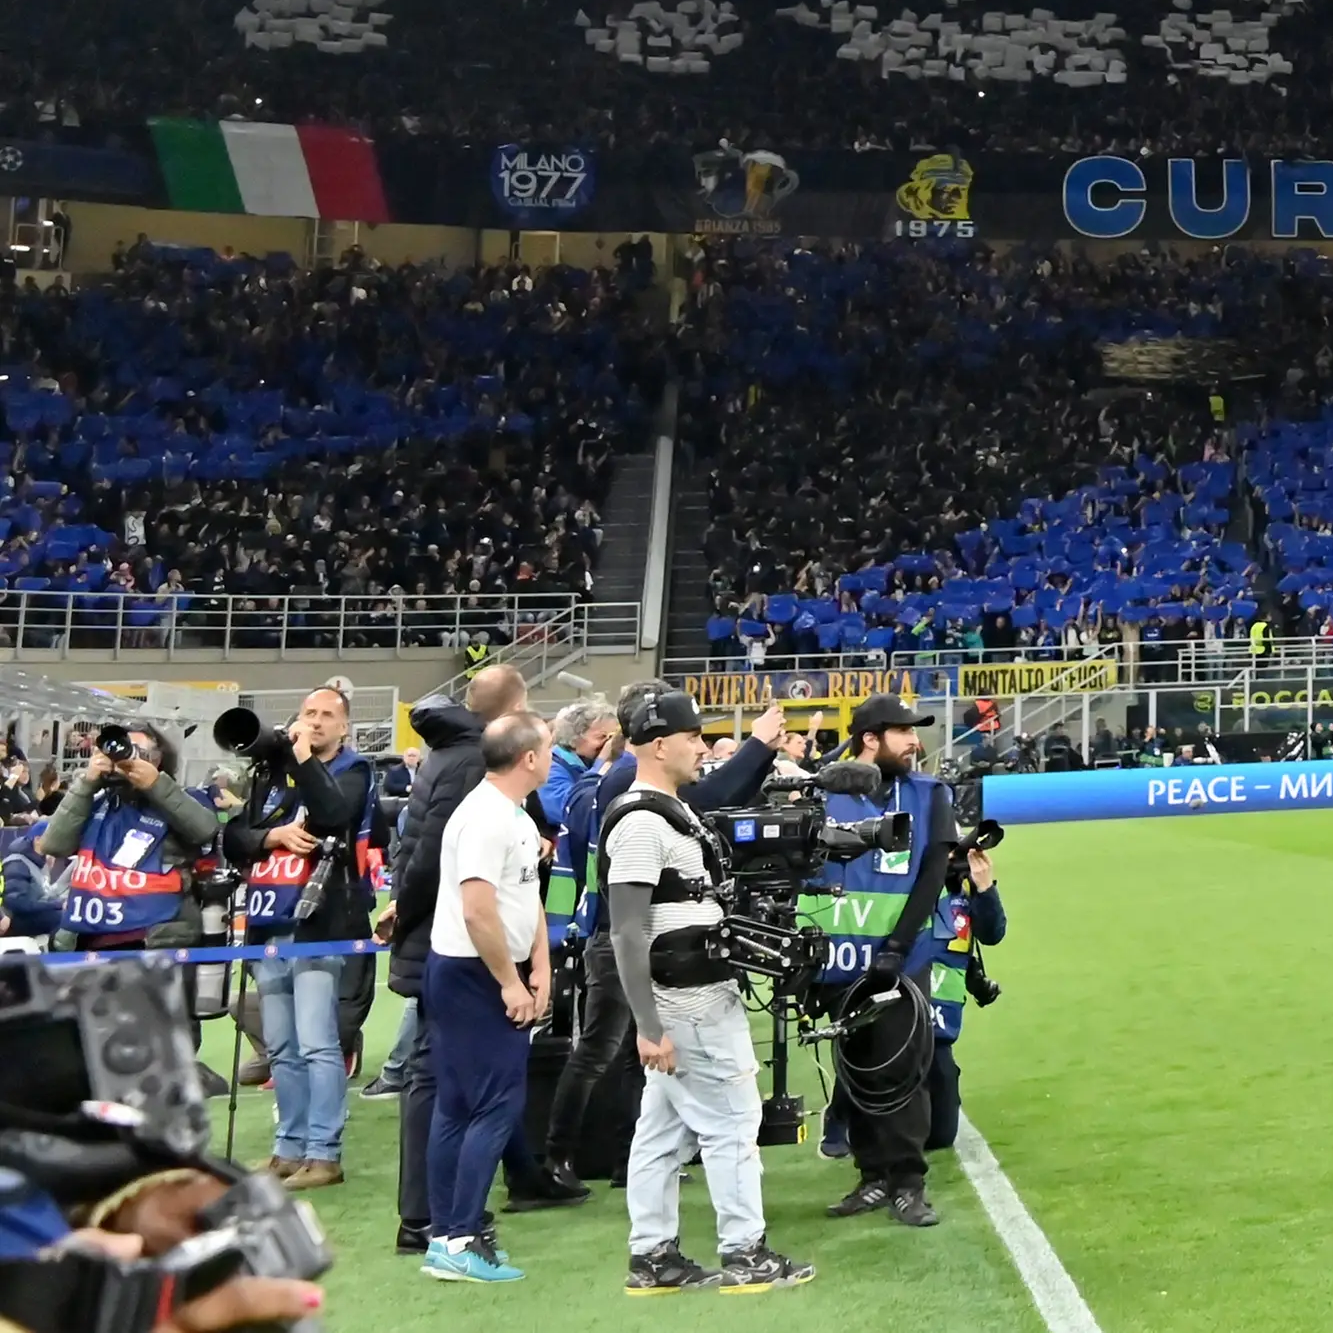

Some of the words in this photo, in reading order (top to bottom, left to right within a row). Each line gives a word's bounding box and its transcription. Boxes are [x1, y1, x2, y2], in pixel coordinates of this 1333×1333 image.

[501, 152, 585, 172] MILANO
[498, 170, 587, 199] 1977
[895, 219, 974, 238] 1975
[684, 674, 772, 712] RIVIERA
[828, 670, 914, 700] BERICA
[962, 667, 1045, 697] MONTALTO
[1148, 775, 1247, 806] PEACE
[71, 856, 148, 890] HOTO
[70, 896, 124, 925] 103
[247, 890, 276, 917] 02
[830, 899, 874, 928] TV
